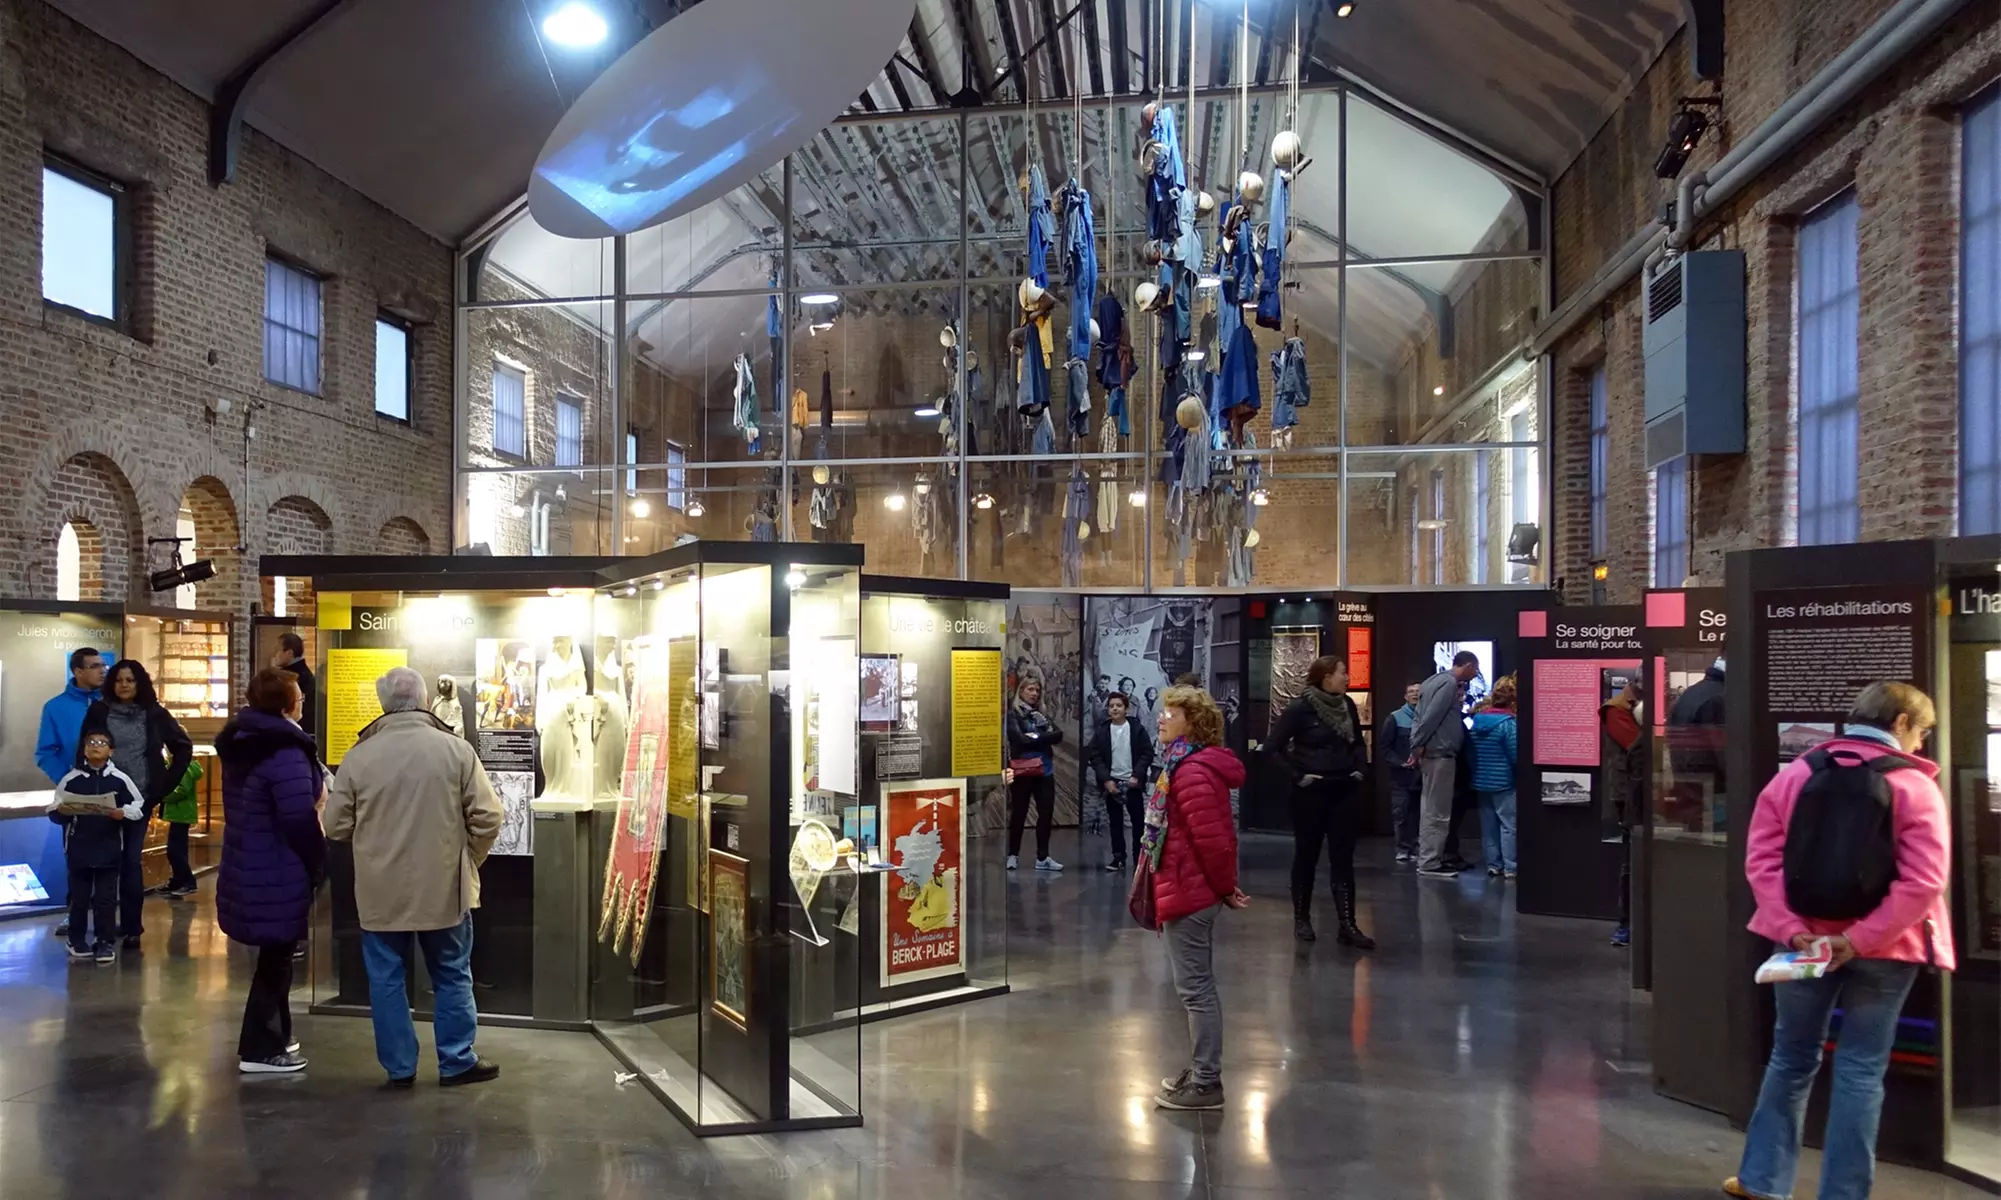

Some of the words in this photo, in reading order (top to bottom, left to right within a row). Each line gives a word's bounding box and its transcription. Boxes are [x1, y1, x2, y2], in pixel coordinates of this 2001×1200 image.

[1767, 604, 1795, 618] Les
[1800, 600, 1913, 617] réhabilitations
[360, 611, 406, 631] Sain
[17, 624, 49, 638] Jules
[1556, 624, 1576, 637] Se
[1580, 624, 1636, 640] soigner
[1699, 630, 1716, 642] Le
[1556, 640, 1568, 649] La
[1570, 639, 1599, 649] santé
[1601, 642, 1624, 651] pour
[893, 932, 908, 947] Une
[892, 940, 956, 966] BERCK-PLAGE
